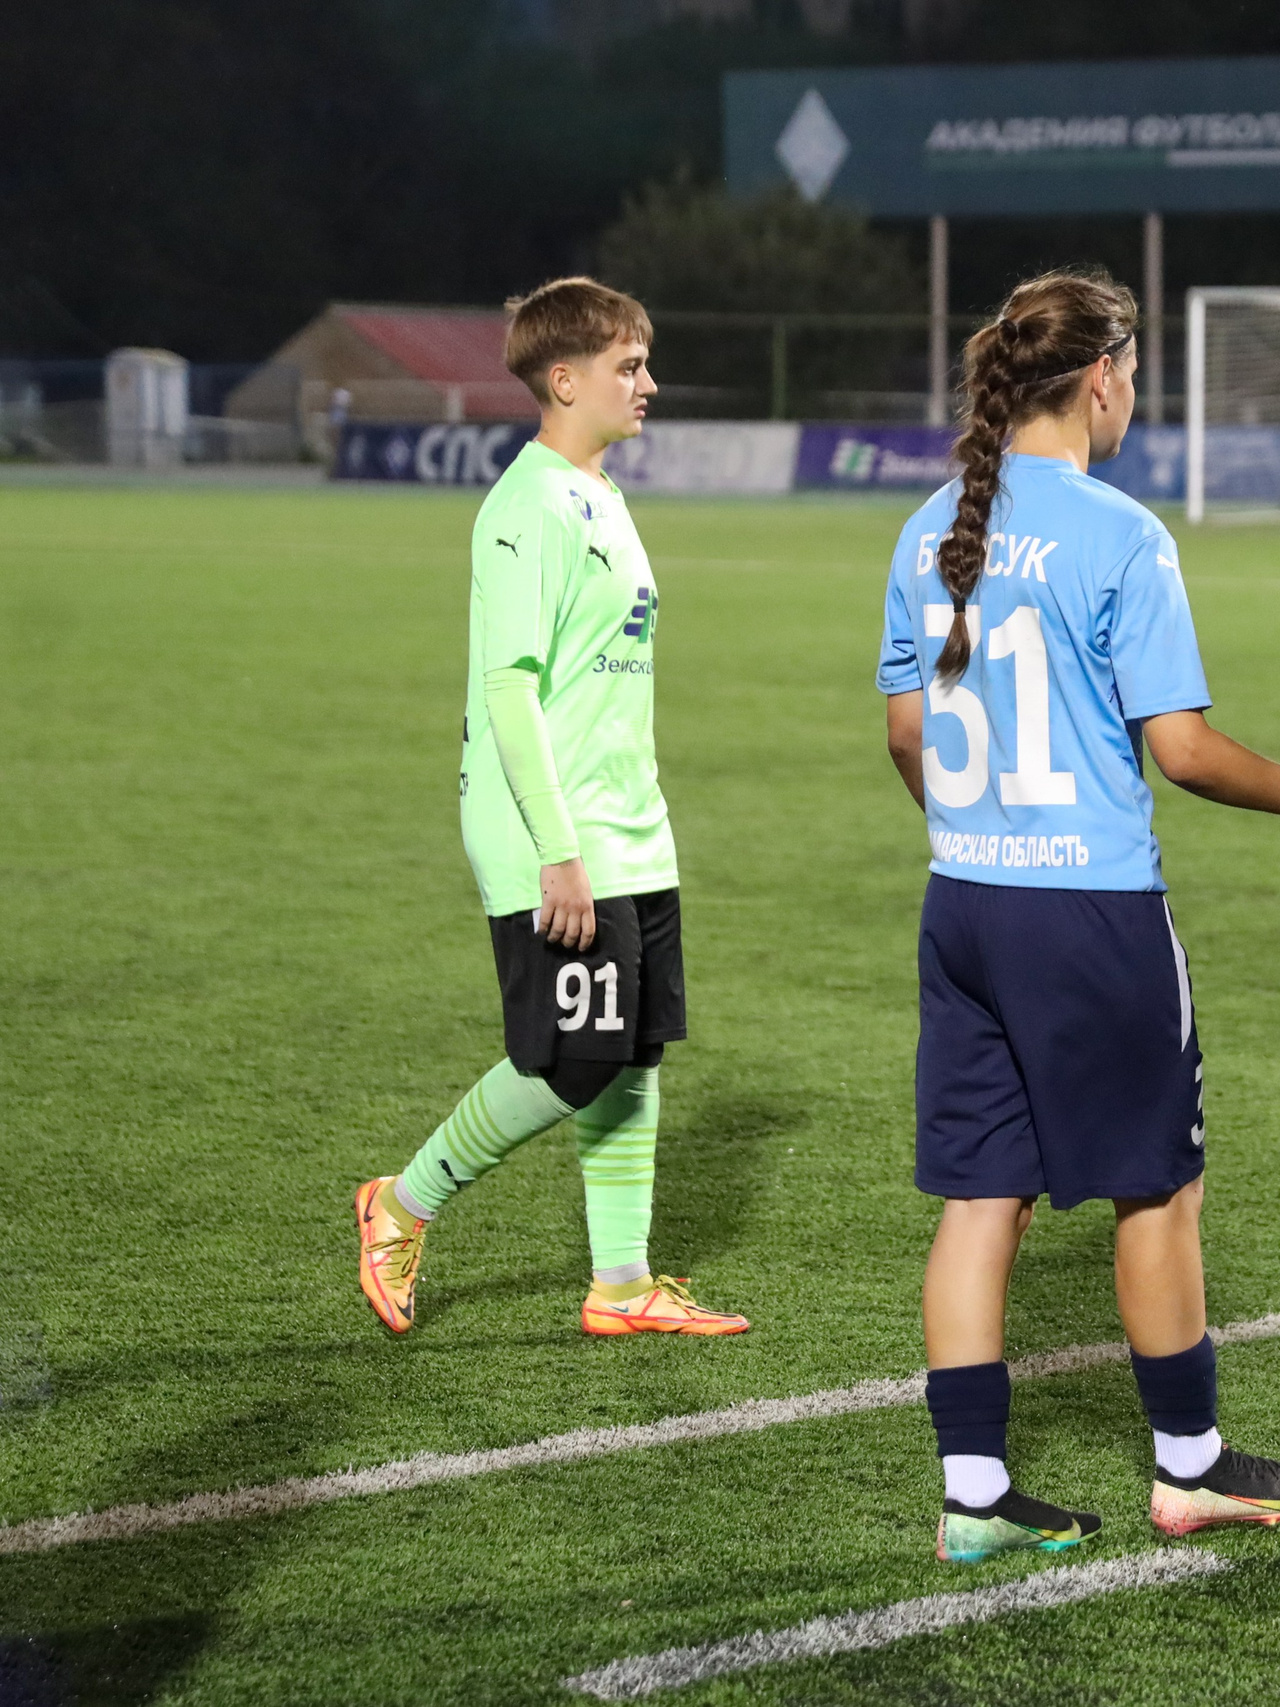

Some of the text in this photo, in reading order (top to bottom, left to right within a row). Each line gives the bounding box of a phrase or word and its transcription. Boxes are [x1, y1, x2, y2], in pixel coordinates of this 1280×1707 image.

[927, 116, 1129, 152] АКАДЕМИЯ
[916, 532, 1059, 583] БСУК
[930, 831, 1089, 867] МАРСКАЯ ОБЛАСТЬ
[556, 962, 624, 1031] 91
